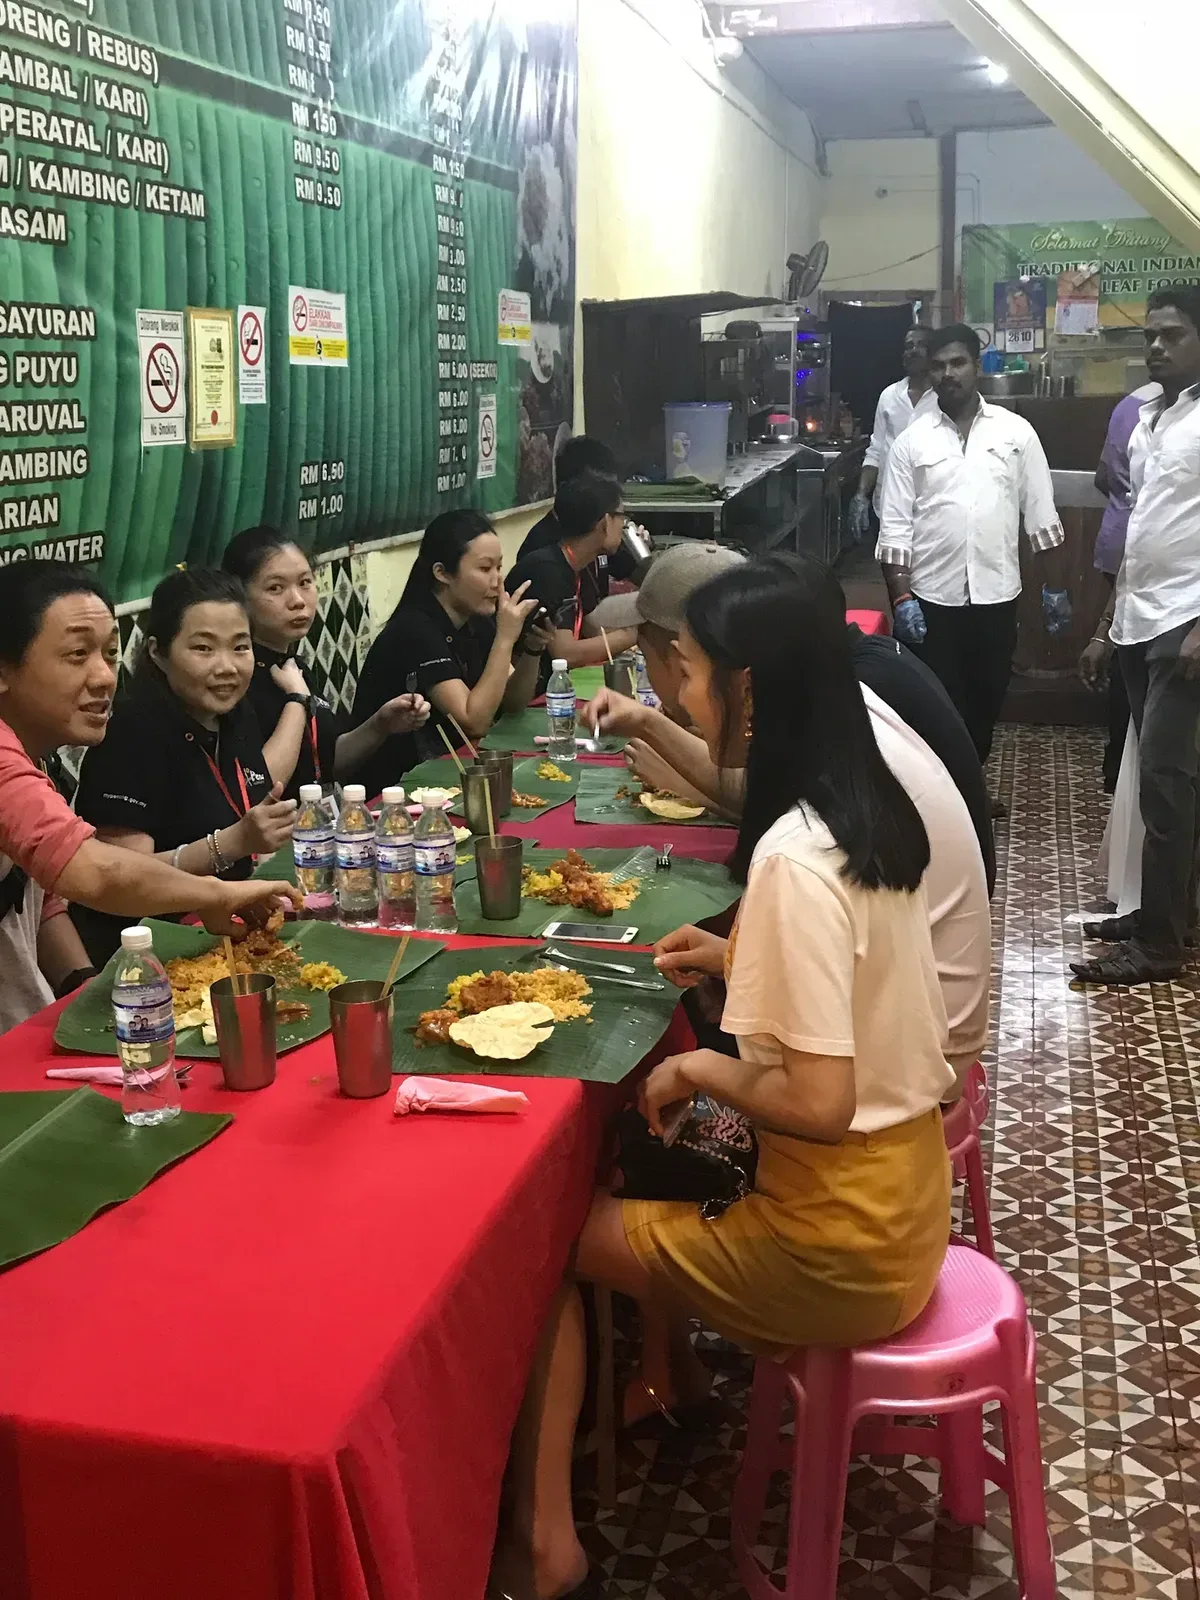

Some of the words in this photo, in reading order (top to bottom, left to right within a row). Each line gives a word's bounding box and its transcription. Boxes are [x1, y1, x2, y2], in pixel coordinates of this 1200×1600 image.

[286, 25, 305, 53] RM
[87, 29, 158, 83] REBUS)
[0, 50, 78, 99] AMBAL
[94, 79, 149, 124] KARI)
[289, 63, 308, 91] RM
[292, 101, 309, 128] RM
[0, 102, 101, 153] PERATAL
[117, 131, 169, 174] KARI)
[294, 139, 312, 165] RM
[315, 147, 340, 172] 9.50
[433, 153, 447, 174] RM
[28, 160, 131, 205] KAMBING
[145, 183, 205, 218] KETAM
[295, 177, 314, 201] RM
[317, 182, 342, 207] 9.50
[435, 184, 449, 204] RM
[450, 189, 464, 209] 9.0
[438, 214, 449, 233] RM
[1031, 231, 1100, 251] Selamat
[1103, 229, 1172, 252] Datang
[437, 274, 449, 292] RM
[450, 277, 466, 294] 2.50
[1101, 278, 1142, 294] LEAF
[437, 304, 449, 321] RM
[451, 304, 466, 322] 2.50
[438, 333, 450, 350] RM
[451, 334, 466, 350] 2.00
[1008, 331, 1020, 343] 26
[16, 356, 77, 384] PUYU
[439, 362, 451, 379] RM
[439, 391, 451, 408] RM
[0, 404, 85, 432] ARUVAL
[440, 420, 451, 435] RM
[0, 449, 87, 482] AMBING
[439, 447, 451, 464] RM
[452, 445, 467, 462] 1.0
[300, 464, 319, 486] RM
[322, 461, 344, 482] 6.50
[437, 475, 450, 492] RM
[451, 473, 467, 489] 1.00
[0, 497, 58, 530] RIAN
[299, 498, 317, 520] RM
[320, 494, 343, 516] 1.00
[34, 535, 104, 563] WATER
